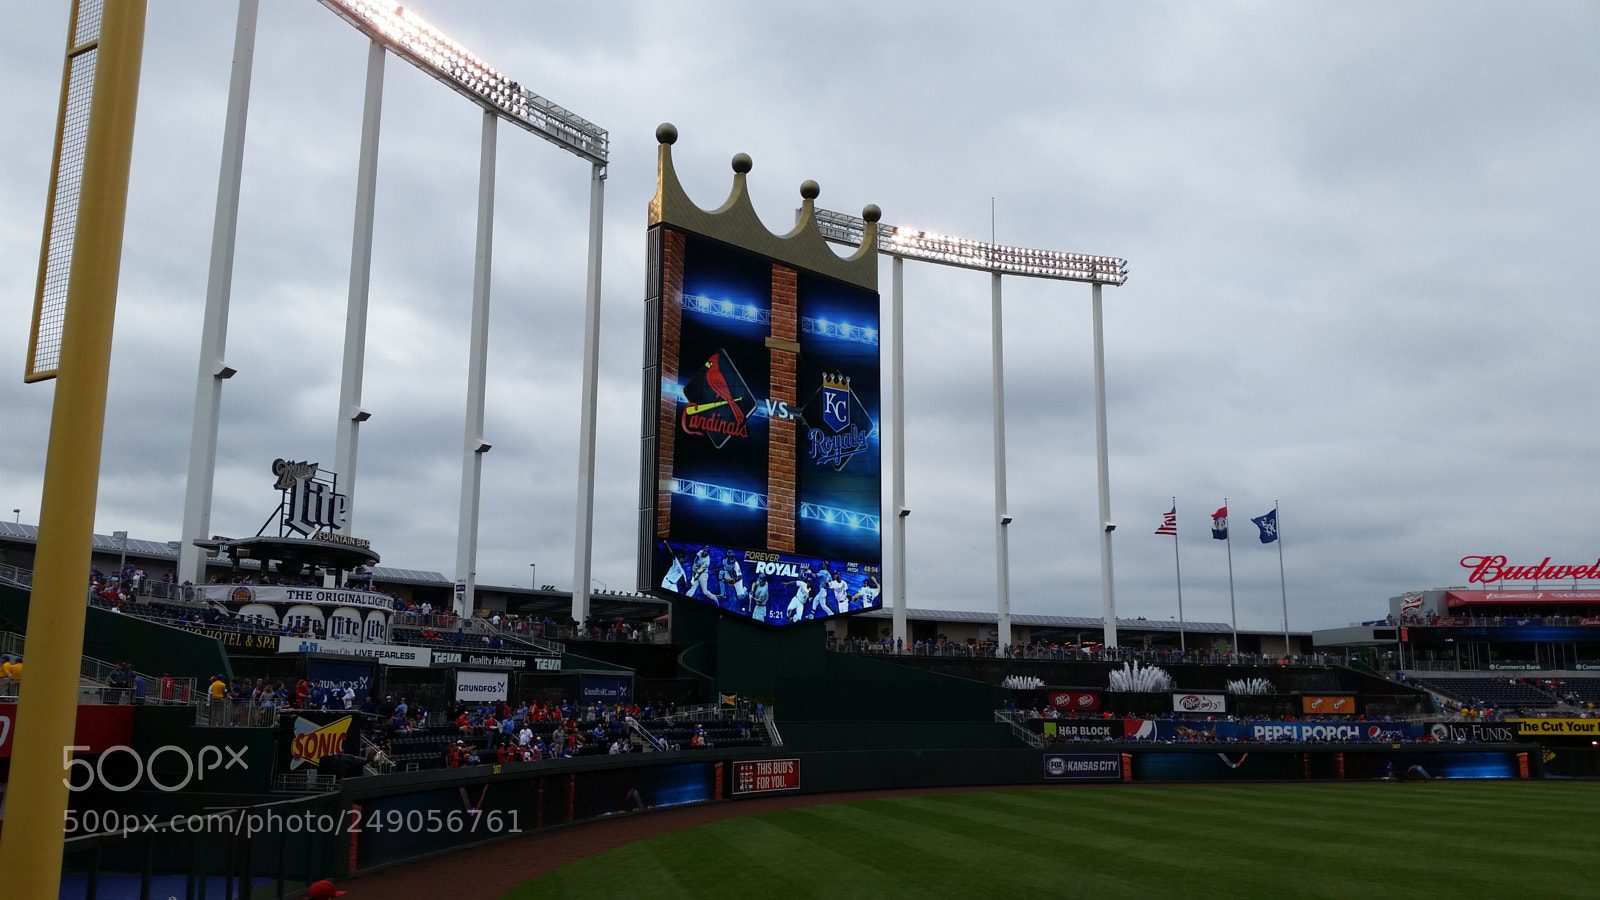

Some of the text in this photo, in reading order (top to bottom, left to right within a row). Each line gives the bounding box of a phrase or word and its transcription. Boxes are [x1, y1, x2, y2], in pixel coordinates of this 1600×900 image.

[765, 399, 794, 419] VS.
[681, 402, 748, 438] Cardinals
[808, 424, 868, 465] Royals
[284, 477, 350, 536] Lite
[316, 531, 371, 549] FOUNTAIN BAR
[744, 551, 780, 562] FOREVER
[756, 561, 799, 577] ROYAL
[1460, 555, 1600, 584] Budwei
[287, 590, 312, 601] THE
[316, 591, 366, 605] ORIGINAL
[367, 596, 387, 608] LIGHT
[769, 610, 783, 619] 5:21
[367, 620, 385, 640] Lite
[245, 635, 253, 647] &
[256, 636, 276, 649] SPA
[354, 649, 372, 657] LIVE
[374, 650, 415, 660] FEARLESS
[432, 652, 562, 671] TEVA Quality Healthcare TEVA
[458, 684, 497, 693] GRUNDFOS
[1058, 726, 1111, 735] H&R BLOCK
[1254, 725, 1360, 741] PEPSI PORCH
[1471, 724, 1513, 741] FUNDS
[1518, 722, 1595, 732] The Cut Your
[293, 732, 347, 760] SONIC
[756, 761, 793, 776] THIS BUD'S
[1067, 760, 1117, 771] KANSAS CITY
[756, 776, 770, 789] FOR
[771, 775, 787, 789] YOU.
